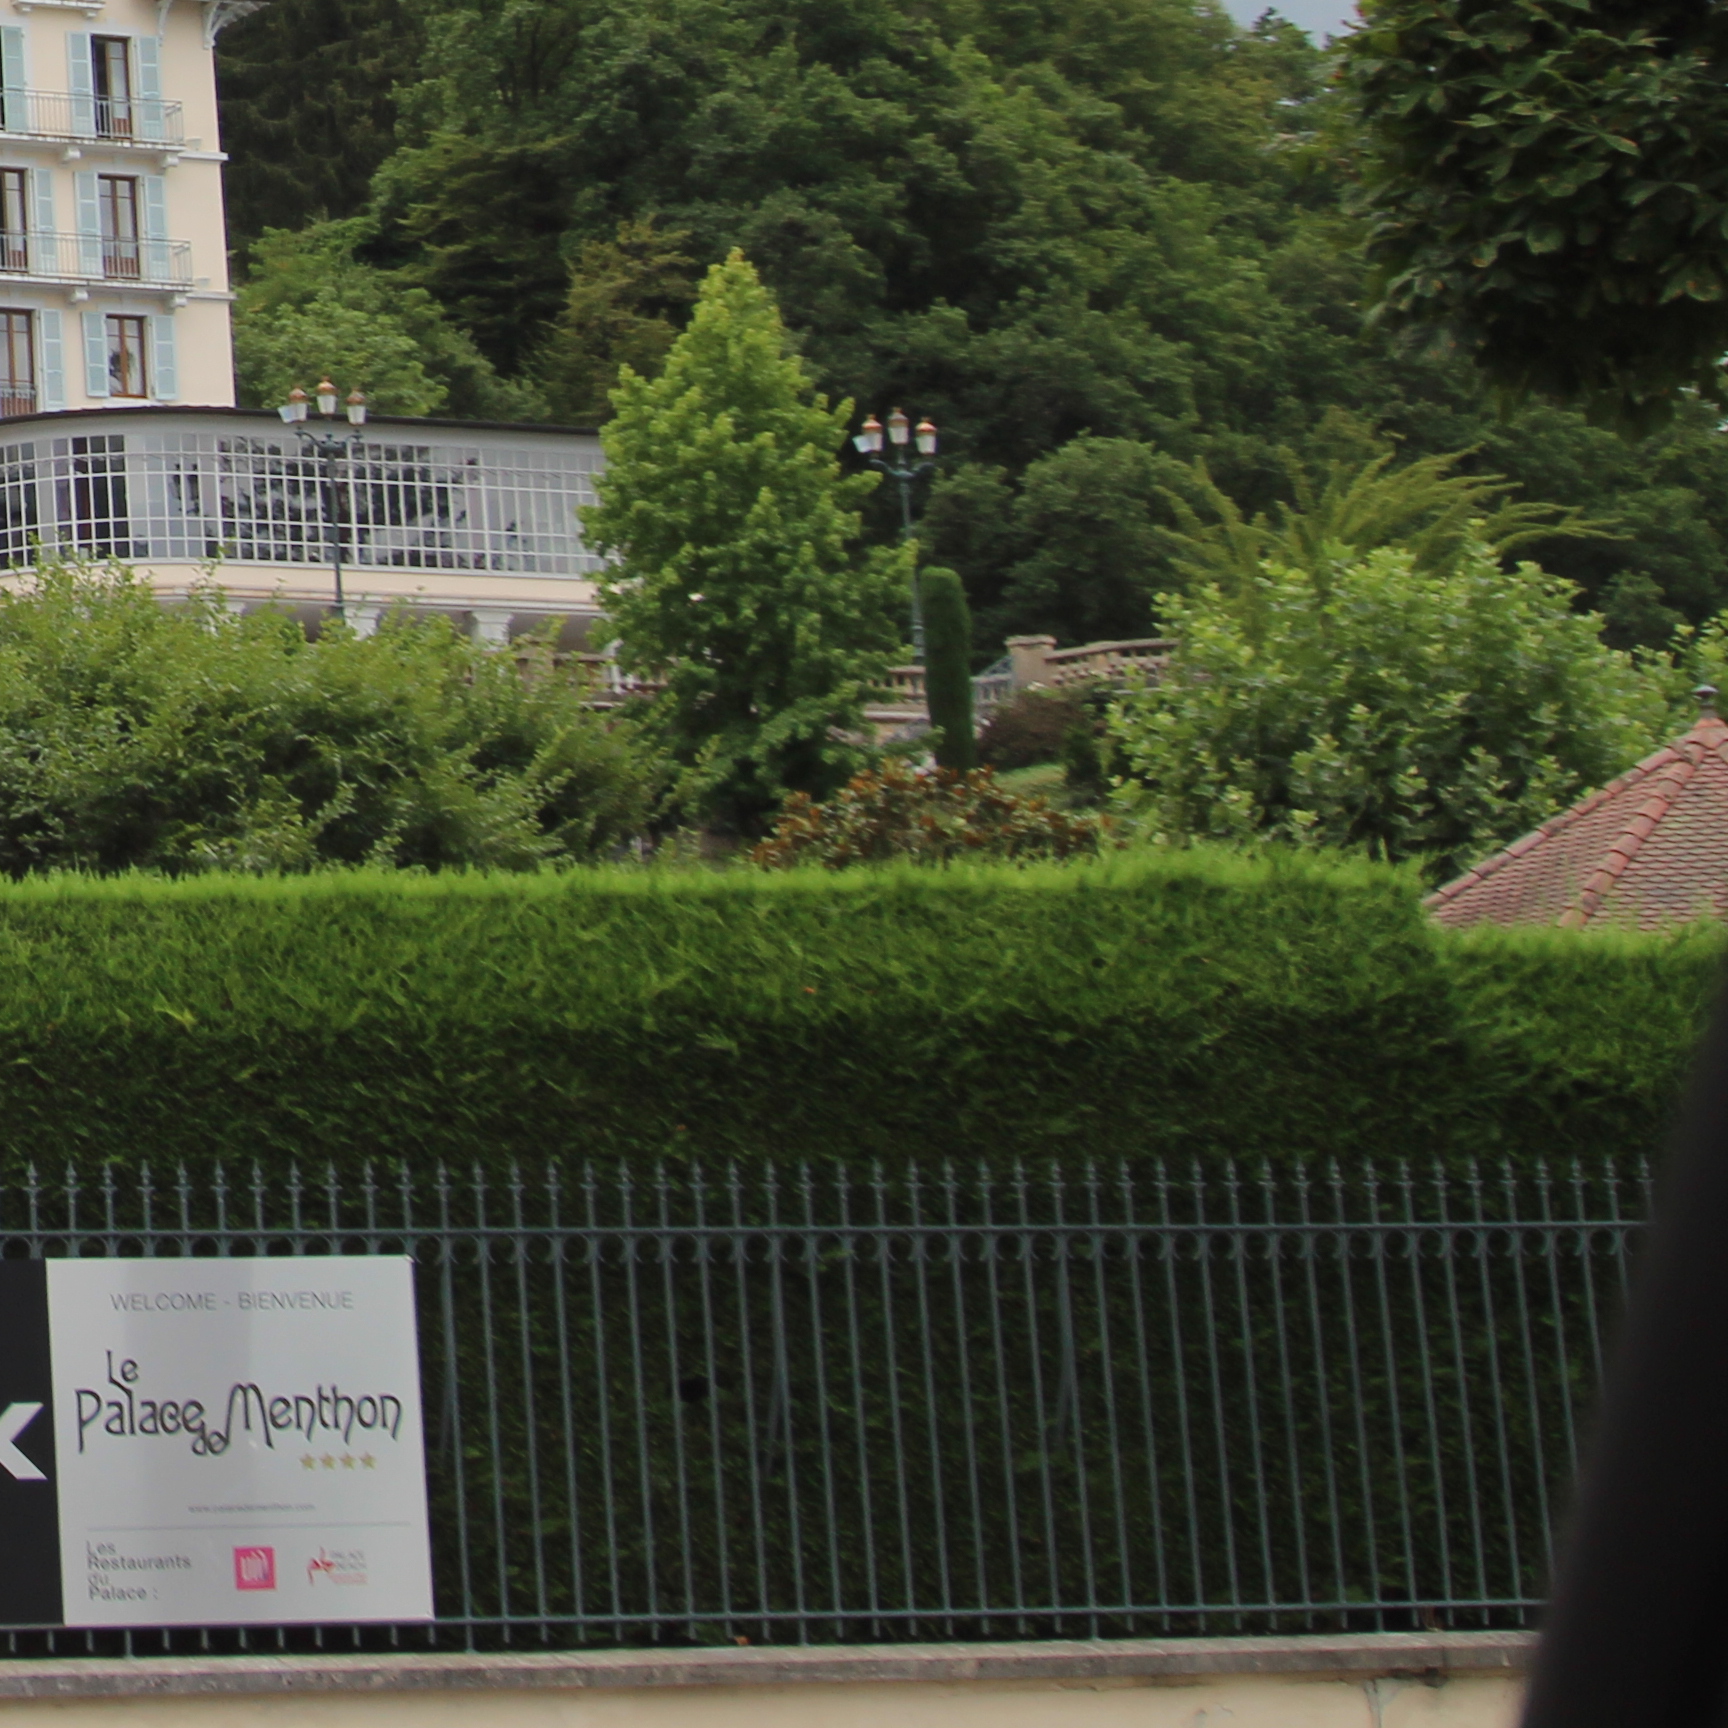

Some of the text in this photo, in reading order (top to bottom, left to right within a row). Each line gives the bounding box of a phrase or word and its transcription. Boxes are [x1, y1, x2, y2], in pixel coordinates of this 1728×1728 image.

[110, 1292, 218, 1312] WELCOME
[238, 1290, 355, 1311] BIENVENUE
[105, 1349, 140, 1385] Le
[74, 1382, 402, 1456] Palace de Menthon
[86, 1540, 116, 1555] Les
[87, 1554, 192, 1571] Restaurants
[87, 1572, 110, 1586] du
[88, 1585, 147, 1600] Palace
